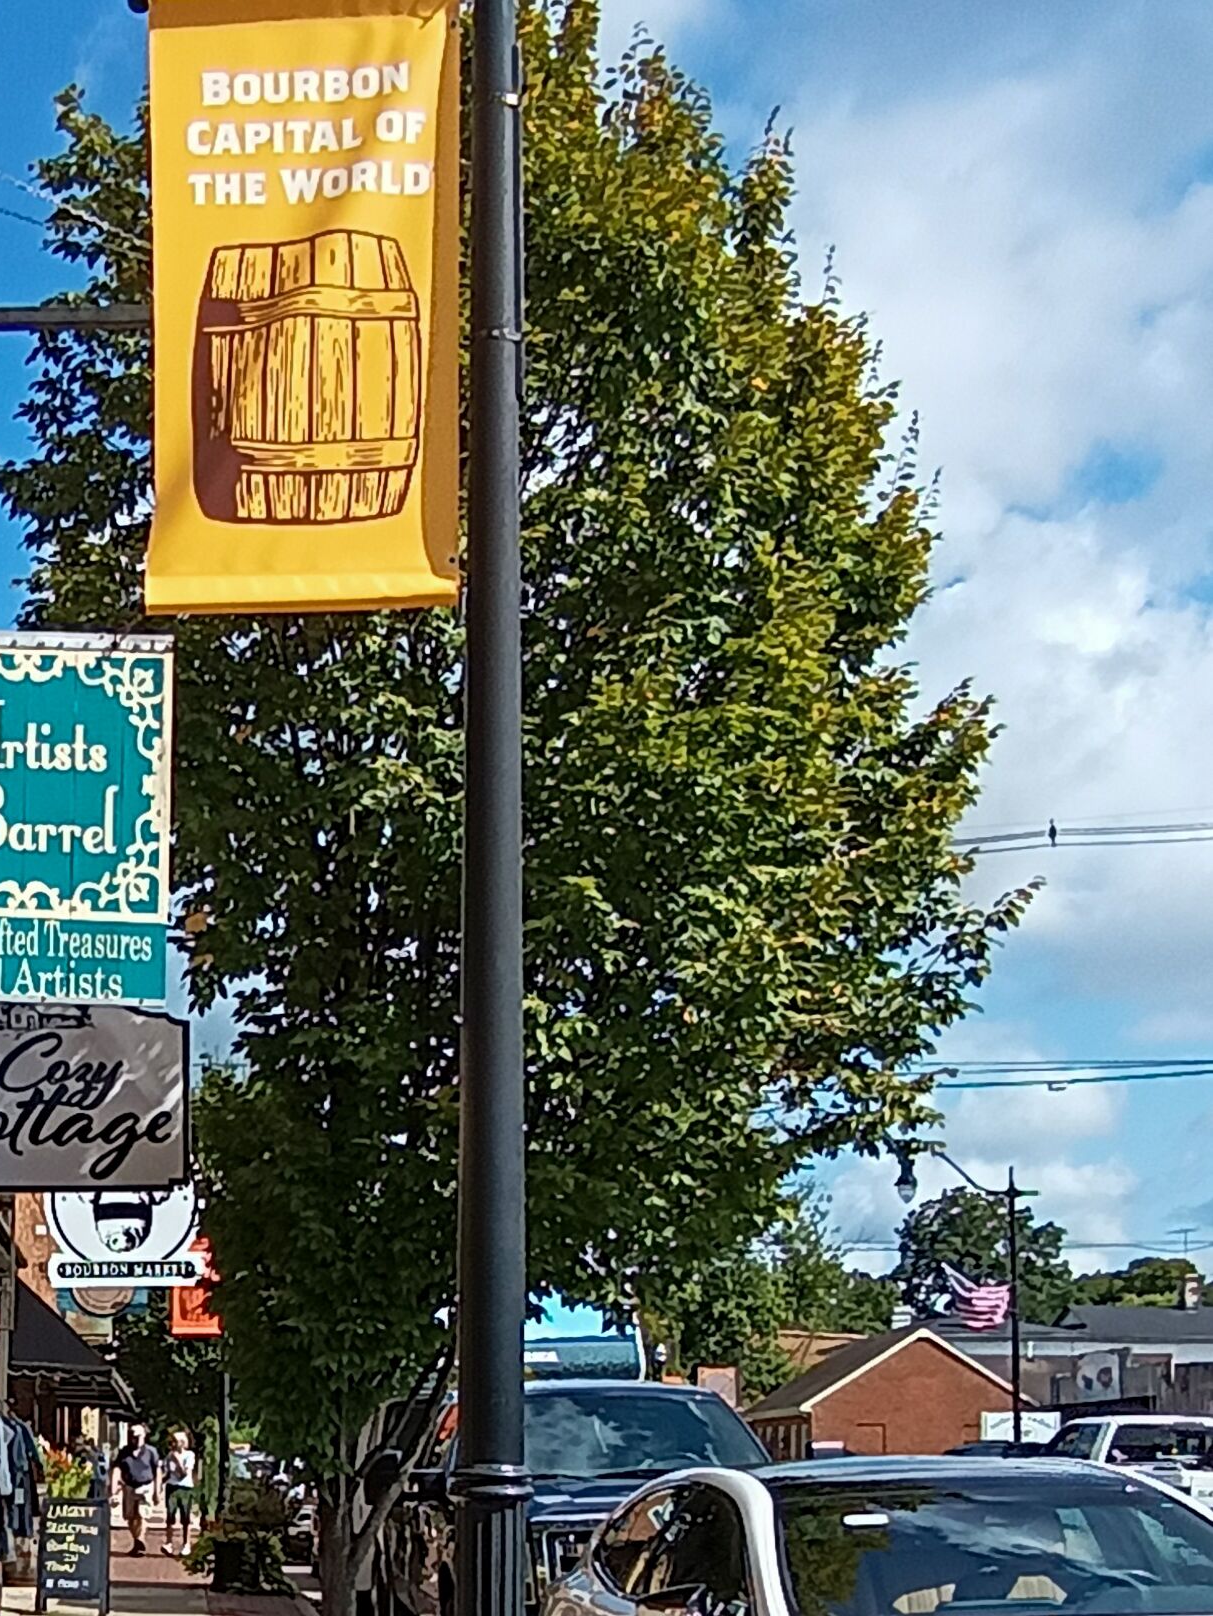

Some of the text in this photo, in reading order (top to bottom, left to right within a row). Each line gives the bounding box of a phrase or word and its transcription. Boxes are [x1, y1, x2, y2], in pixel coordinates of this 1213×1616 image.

[201, 62, 409, 106] BOURBON
[187, 110, 427, 156] CAPITAL OF
[187, 160, 434, 206] THE WORLD
[43, 919, 152, 961] Treasures
[13, 957, 123, 999] Artists
[65, 1262, 128, 1277] BOURBON
